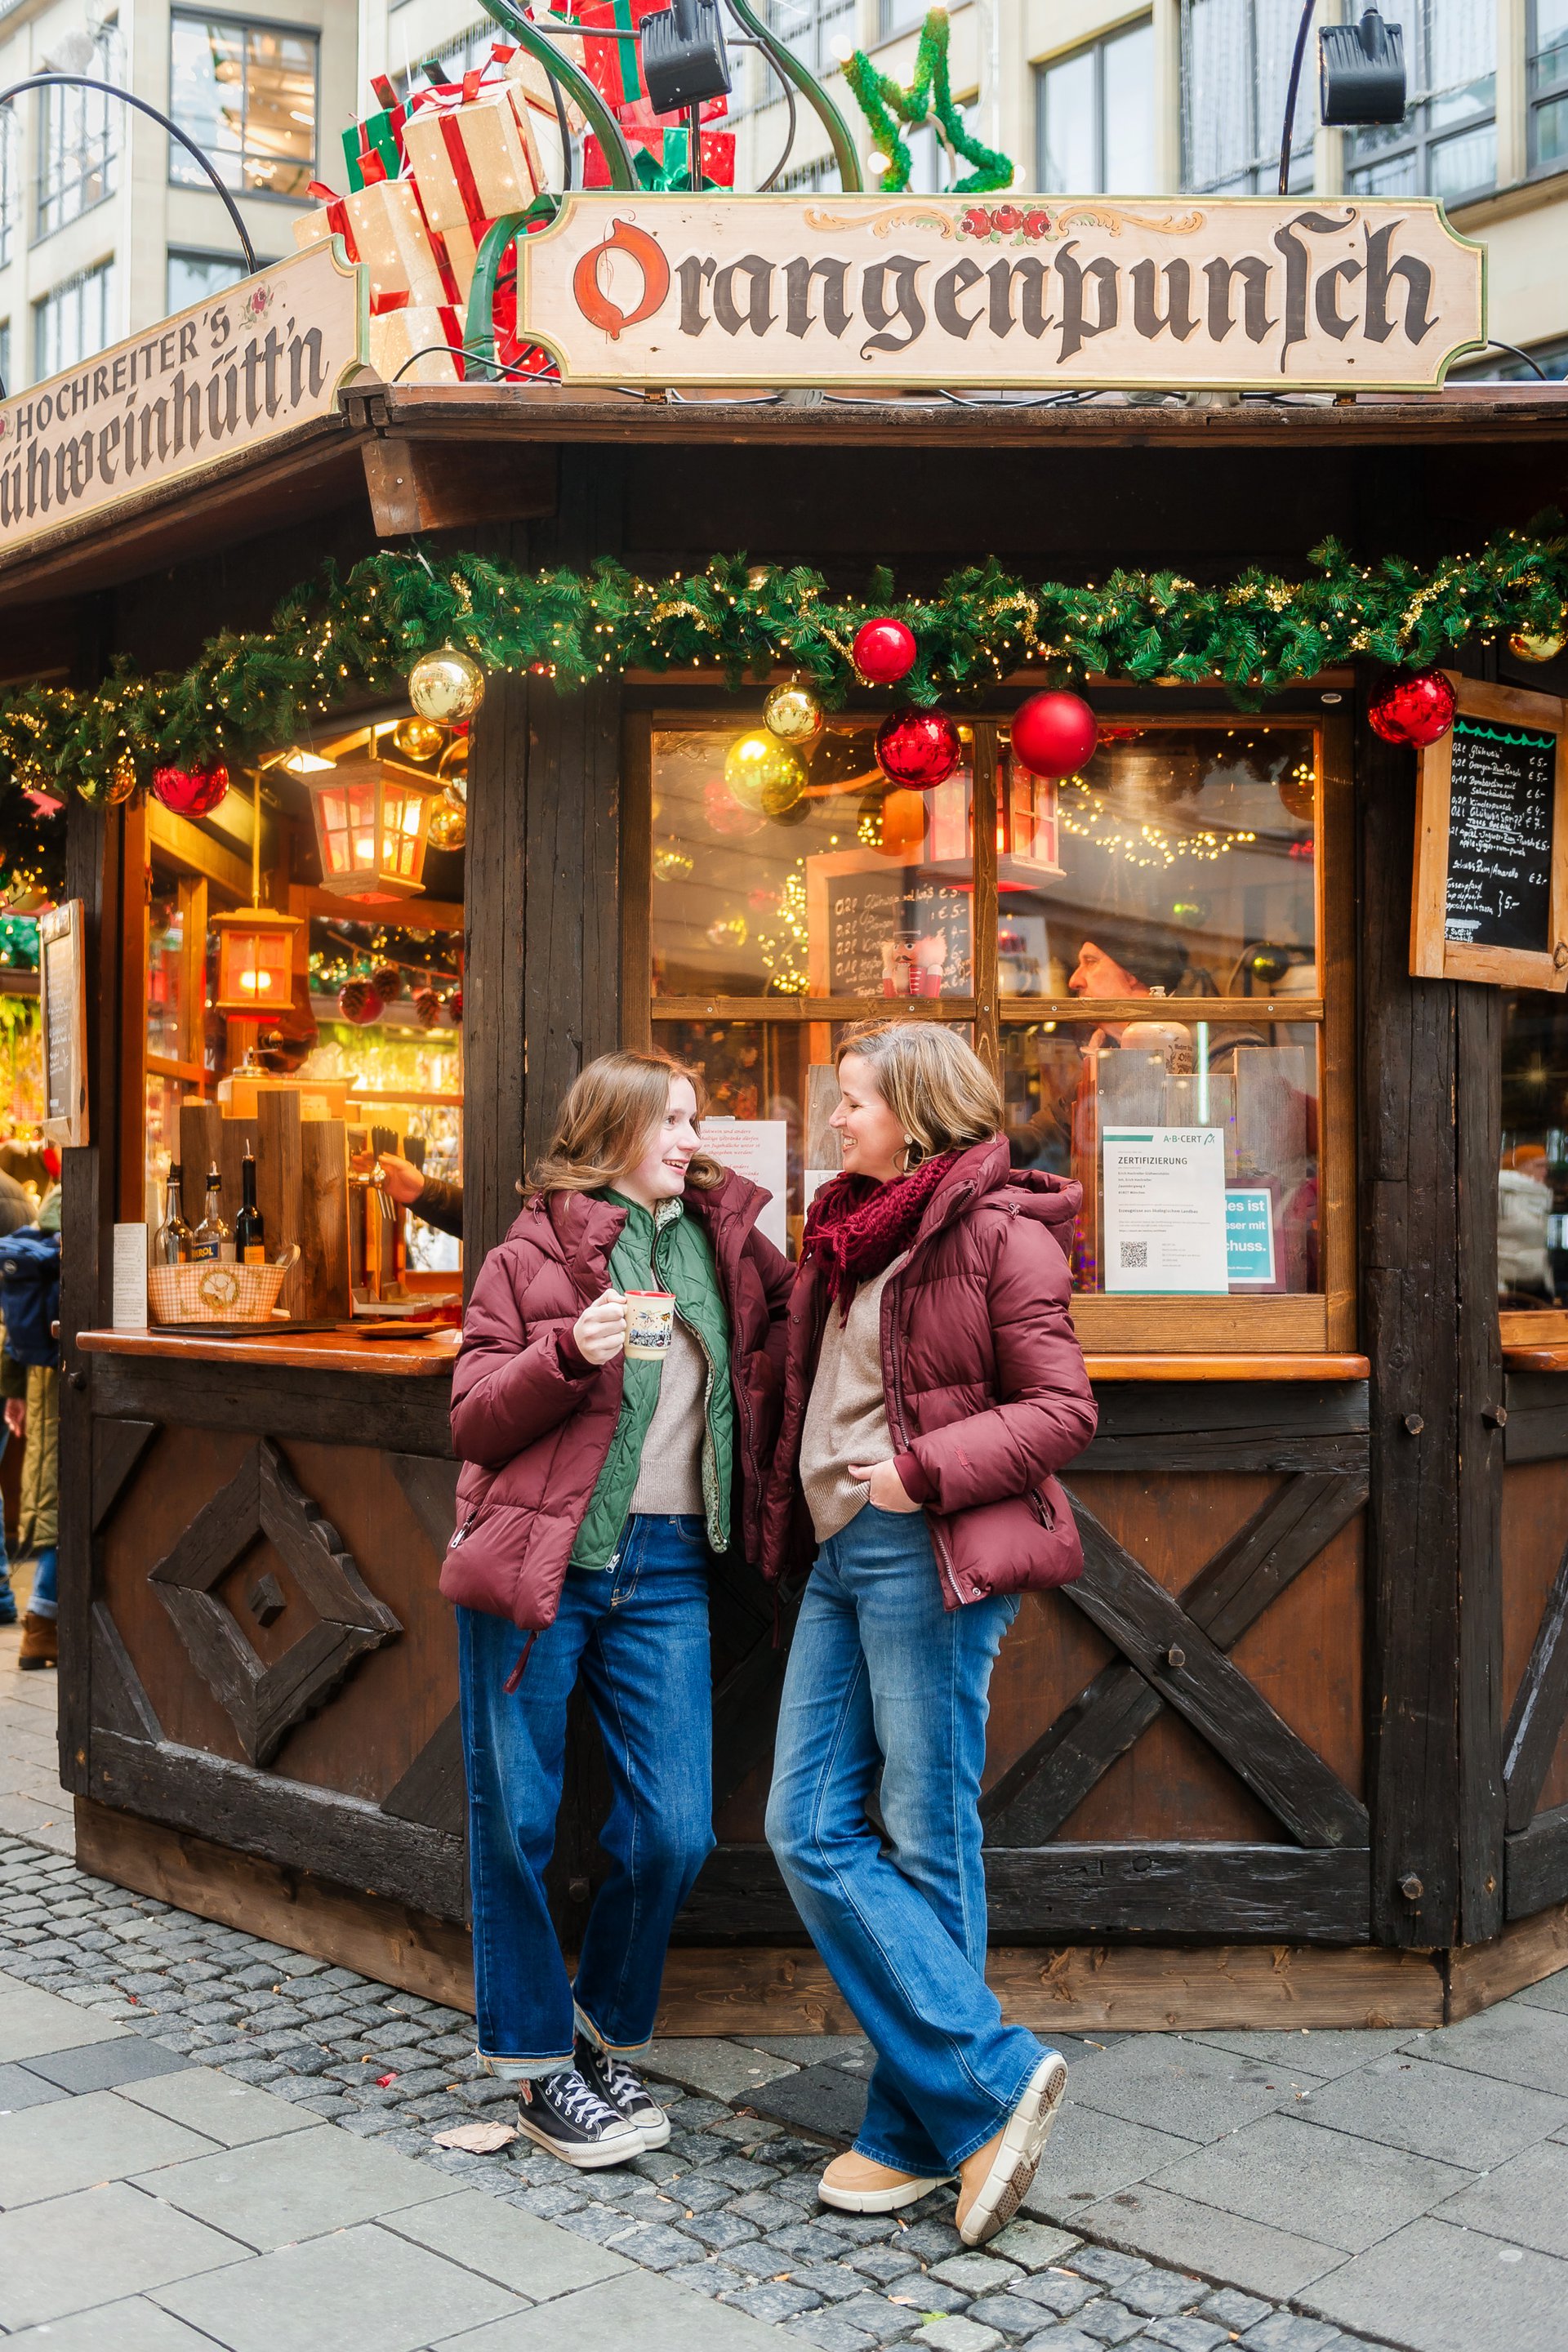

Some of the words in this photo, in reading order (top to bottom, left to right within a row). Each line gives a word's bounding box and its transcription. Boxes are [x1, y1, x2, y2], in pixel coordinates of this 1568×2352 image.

[16, 305, 231, 443] HOCHREITER'S
[1469, 797, 1512, 812] Kinderpunsch
[1118, 1156, 1188, 1165] ZERTIFIZIERUNG
[1247, 1200, 1265, 1212] ist
[1248, 1221, 1266, 1230] mit
